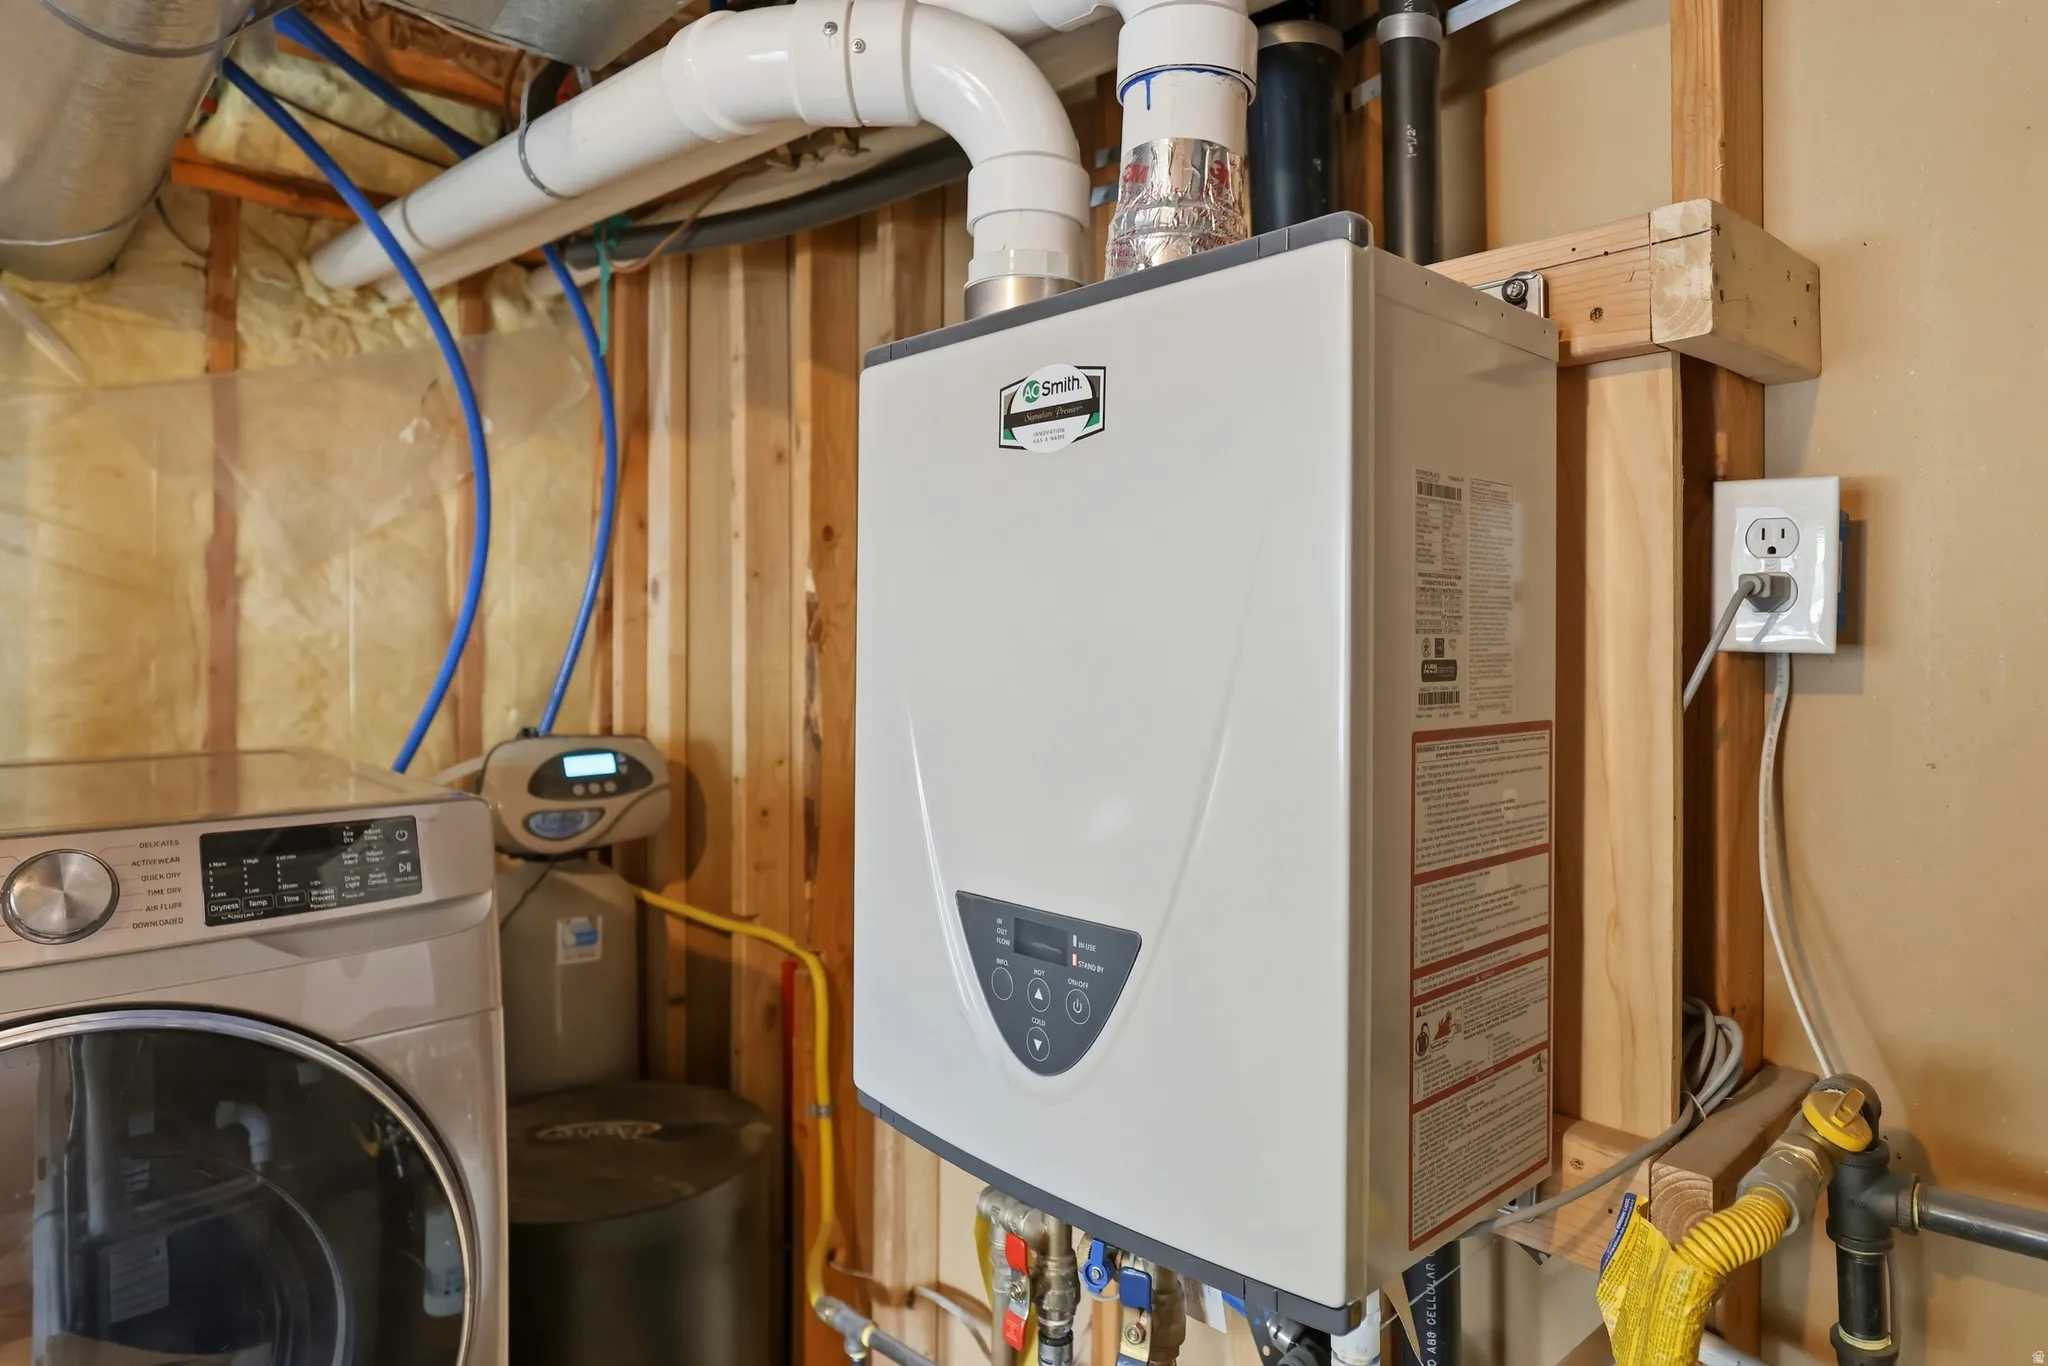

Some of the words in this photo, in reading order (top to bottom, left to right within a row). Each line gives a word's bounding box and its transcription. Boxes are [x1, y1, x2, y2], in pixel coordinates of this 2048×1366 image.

[1123, 164, 1150, 184] 3M
[1032, 427, 1066, 437] INNOVATION
[138, 840, 180, 849] DELICATES
[131, 856, 181, 868] ACTIVEWEAR
[140, 874, 165, 882] QUICK
[166, 872, 181, 880] DRY
[147, 888, 165, 897] TIME
[166, 887, 182, 895] DRY
[283, 894, 300, 903] Time
[311, 894, 335, 902] Prevent
[145, 904, 159, 912] AIR
[160, 902, 183, 911] FLUFF
[210, 902, 239, 912] Dryness
[132, 917, 184, 930] DOWNLOADED
[996, 926, 1008, 936] OUT
[996, 936, 1011, 947] FLOW
[1078, 941, 1085, 950] IN
[1085, 943, 1097, 953] USE
[1078, 960, 1096, 972] STAND
[1096, 965, 1105, 974] BY
[1033, 968, 1046, 977] HOT
[1031, 1016, 1046, 1027] COLD
[1425, 1262, 1438, 1326] CELLULAR
